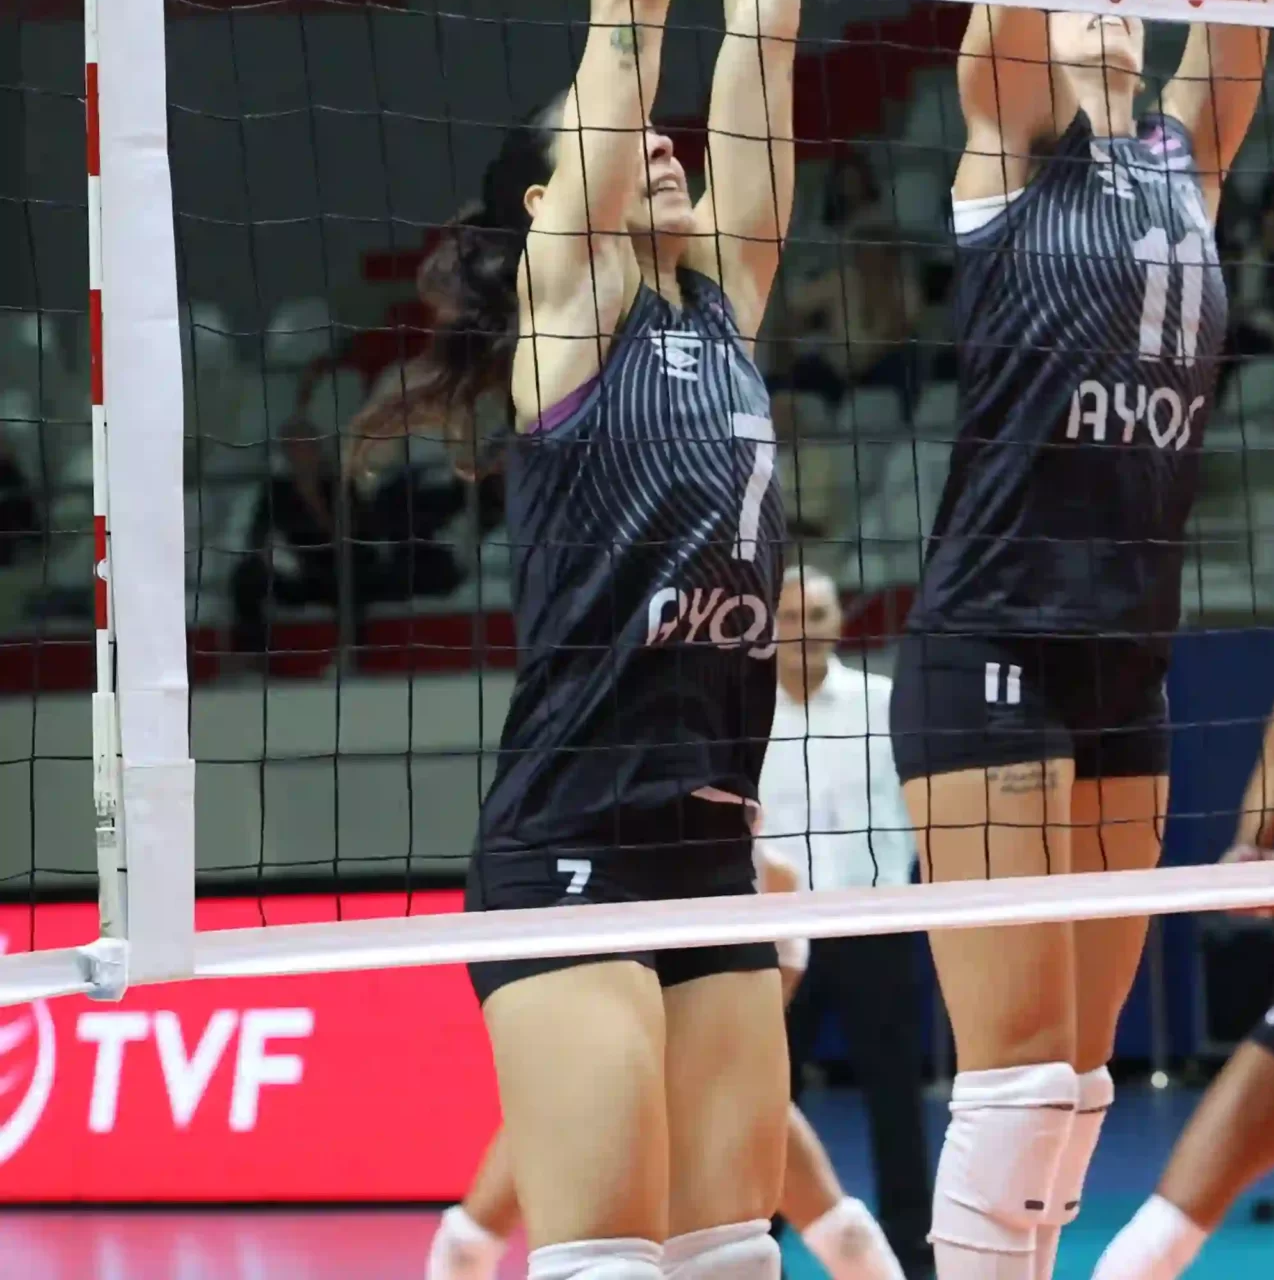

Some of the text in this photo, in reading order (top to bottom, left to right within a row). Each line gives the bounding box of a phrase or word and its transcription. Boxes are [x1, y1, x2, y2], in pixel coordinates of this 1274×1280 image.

[1134, 226, 1204, 367] 11
[728, 412, 774, 562] 7
[645, 586, 778, 660] AYO
[985, 661, 1022, 705] 11
[557, 858, 592, 895] 7
[75, 1007, 316, 1134] TVF
